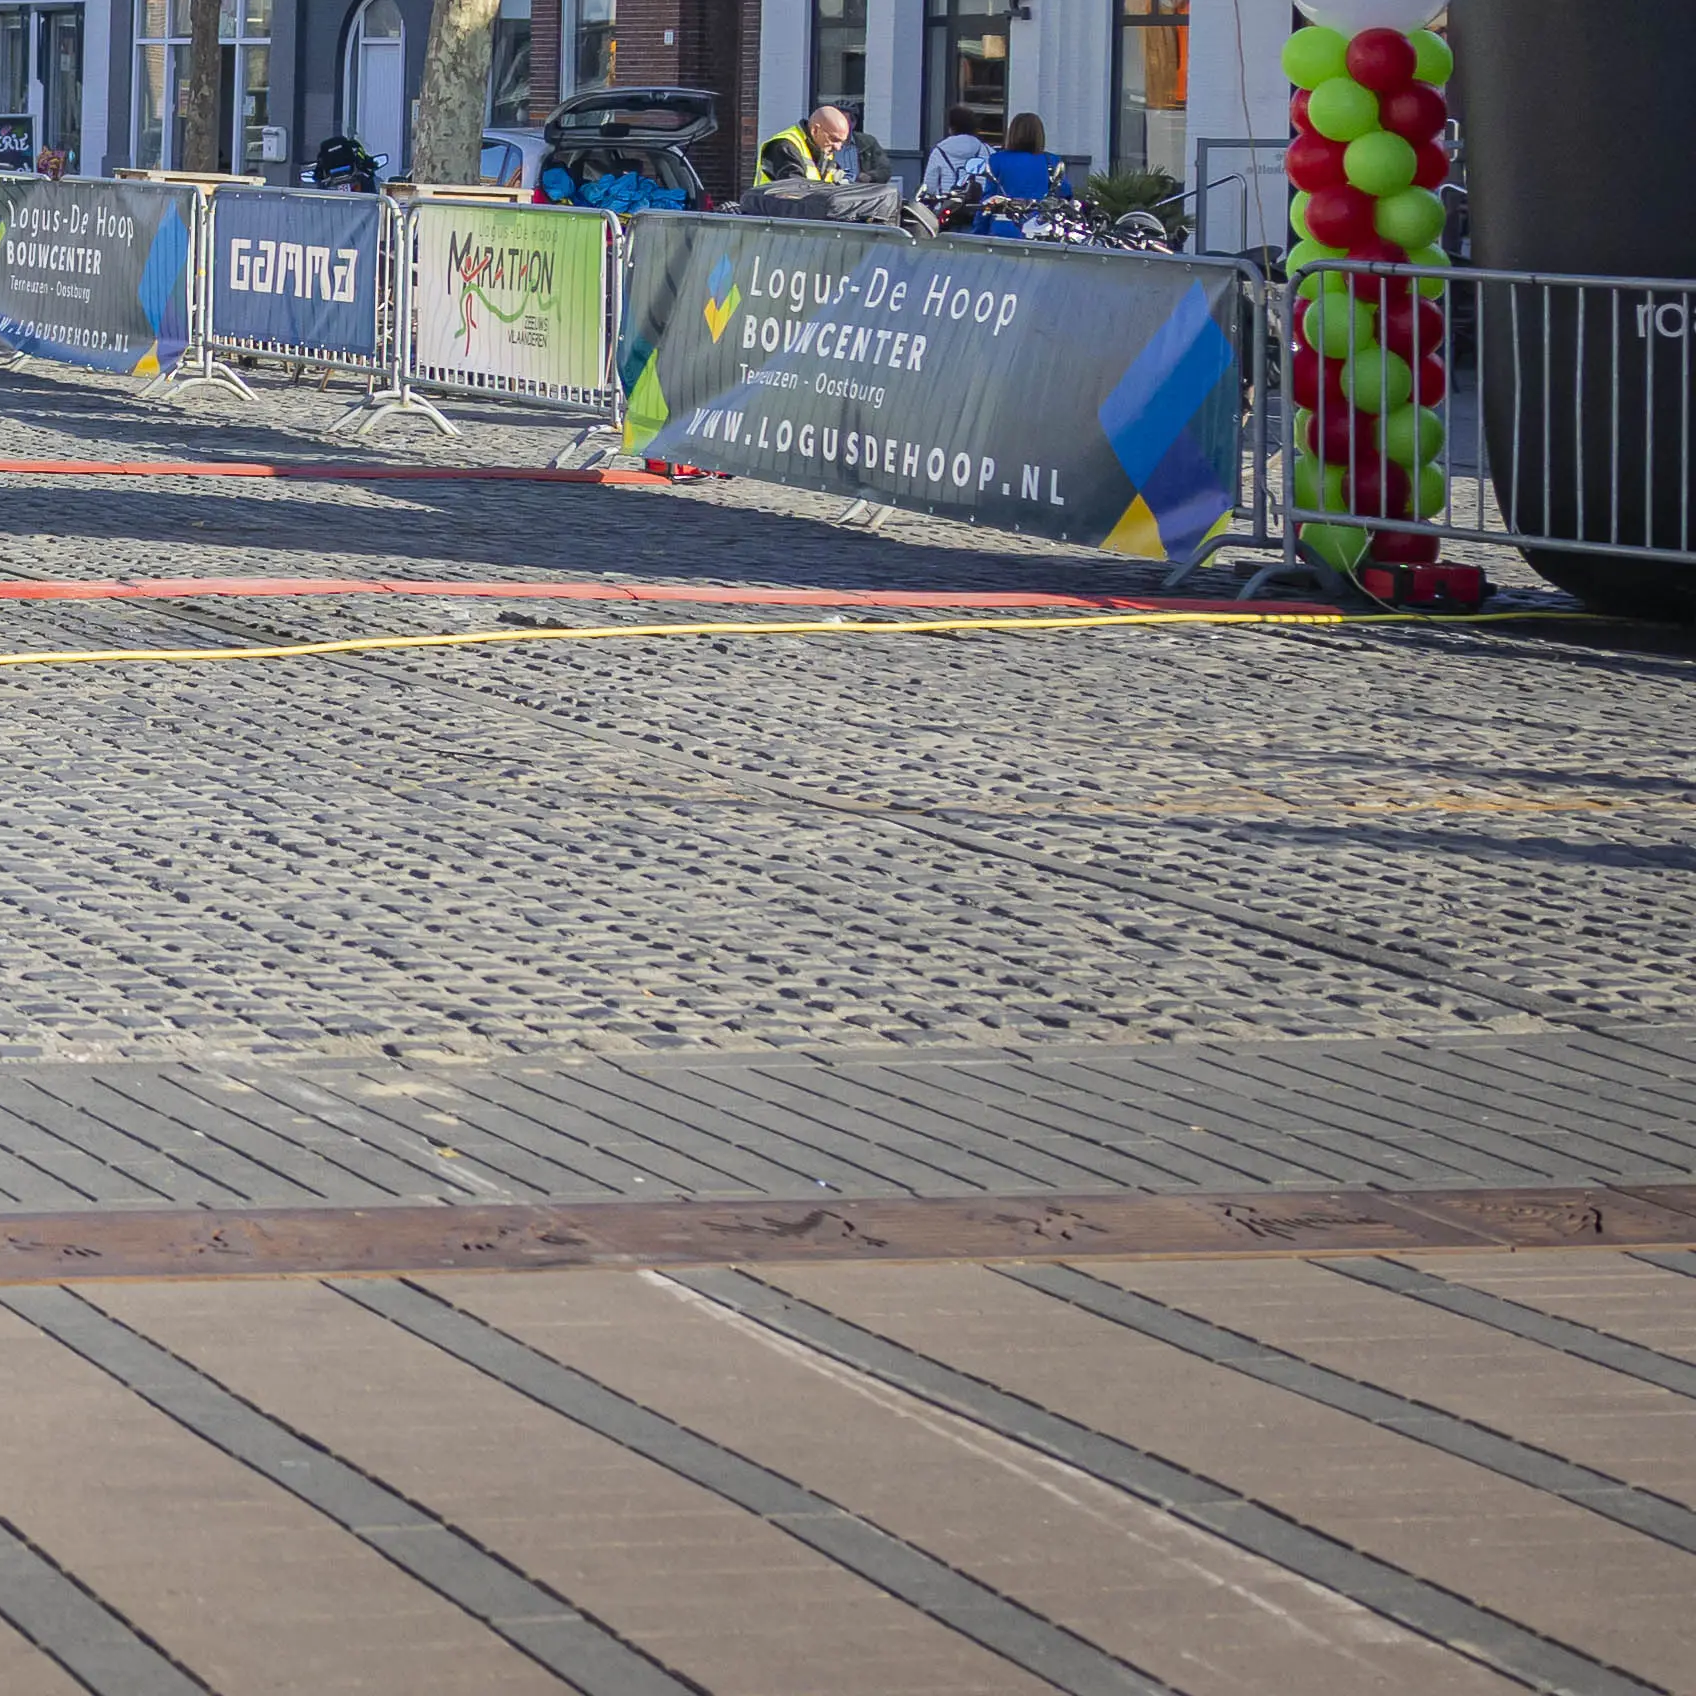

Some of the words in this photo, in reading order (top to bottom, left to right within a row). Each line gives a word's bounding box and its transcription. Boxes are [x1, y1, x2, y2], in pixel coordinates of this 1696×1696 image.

[96, 206, 134, 247] Hoop
[6, 240, 102, 276] BOUWCENTER
[229, 237, 359, 303] GAMMA
[447, 230, 555, 295] MARATHON
[9, 274, 49, 296] Terneuzen
[55, 280, 92, 304] Oostburg
[748, 255, 905, 320] Logus-De
[921, 272, 1019, 336] Hoop
[741, 313, 928, 374] BOUWCENTER
[814, 371, 887, 410] Oostburg
[684, 406, 1066, 506] WWW.LOGUSDEHOOP.NL
